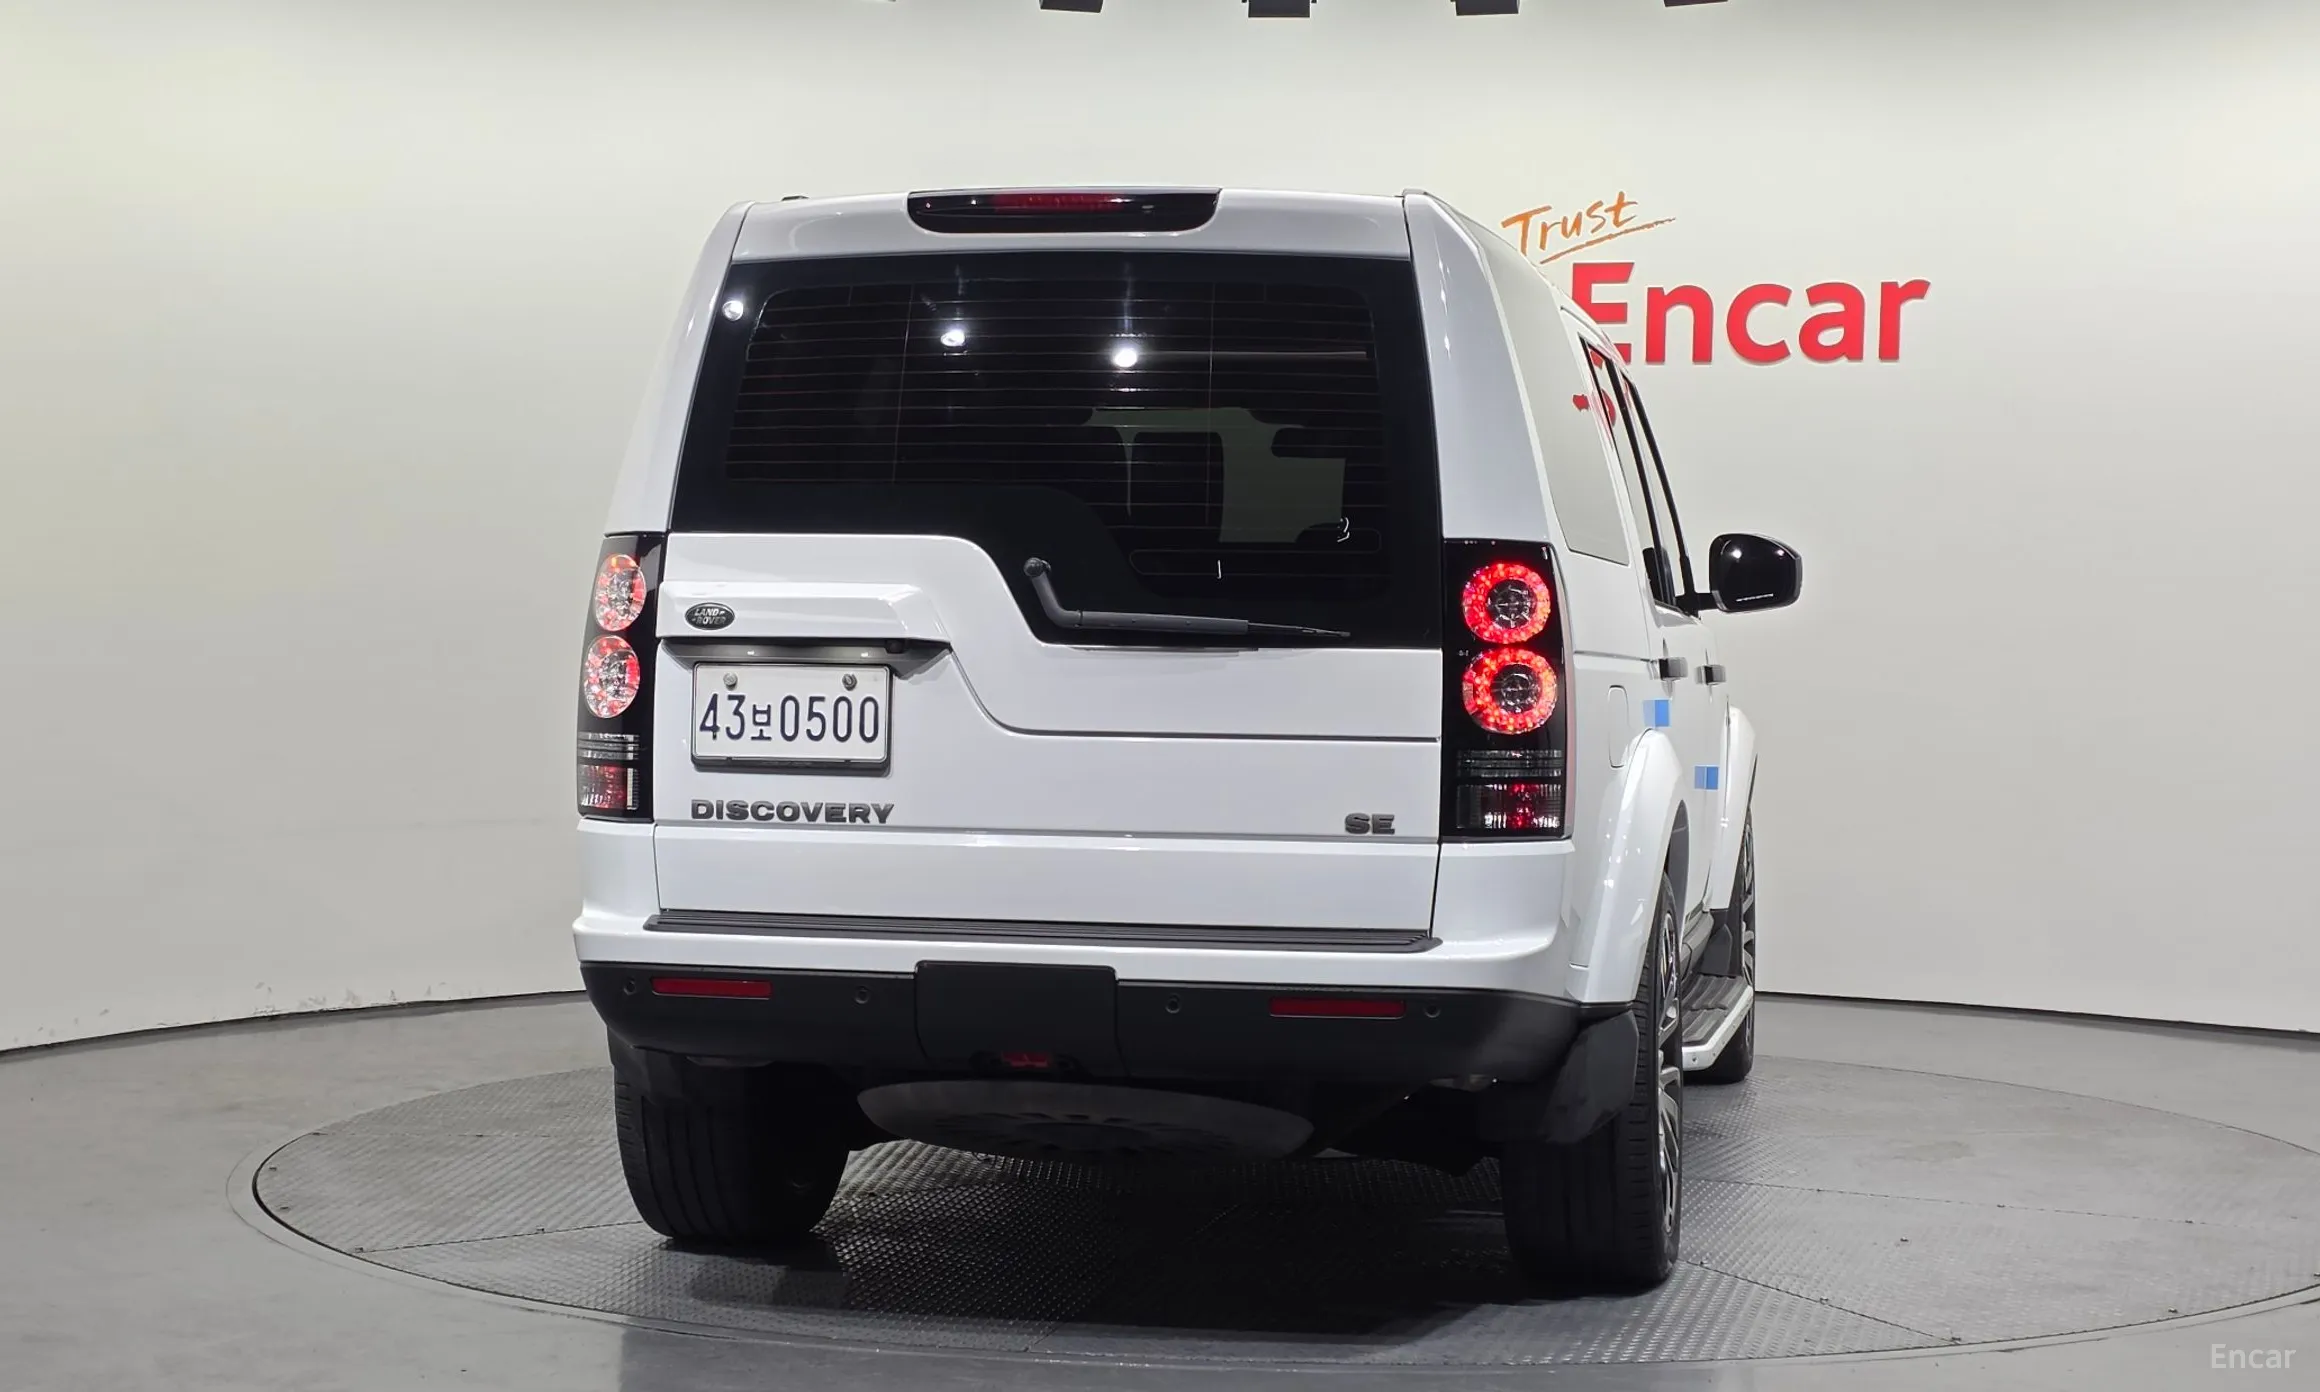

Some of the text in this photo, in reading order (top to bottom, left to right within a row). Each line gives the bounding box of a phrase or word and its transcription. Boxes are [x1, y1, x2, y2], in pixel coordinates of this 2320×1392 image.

[1501, 191, 1638, 256] Trust
[1571, 261, 1931, 365] Encar
[699, 693, 880, 743] 43보0500
[691, 799, 895, 824] DISCOVERY
[1344, 813, 1395, 835] SE
